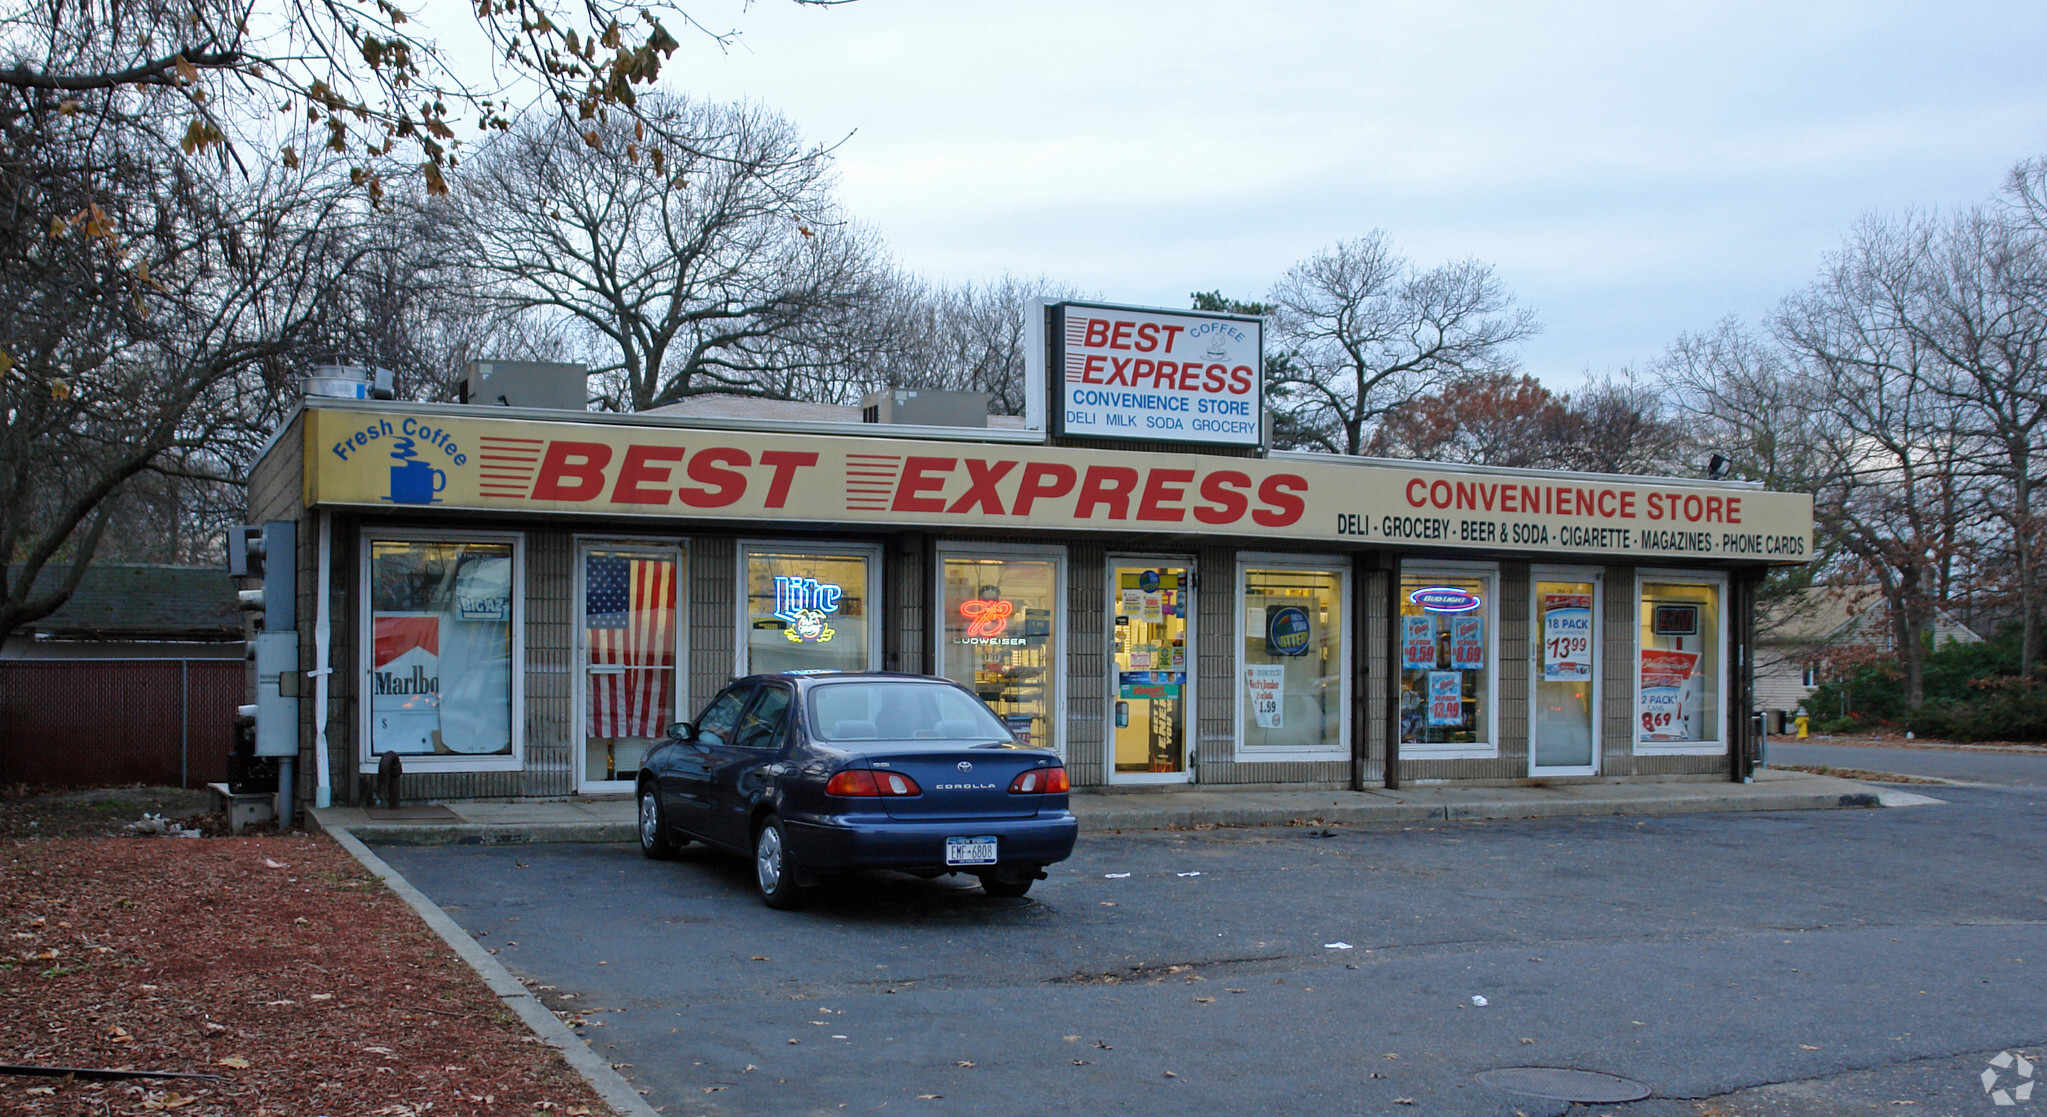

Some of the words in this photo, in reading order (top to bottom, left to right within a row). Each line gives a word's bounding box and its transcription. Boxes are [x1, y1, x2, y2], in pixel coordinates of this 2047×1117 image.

[1084, 318, 1185, 354] BEST
[1190, 322, 1246, 343] COFFEE
[1082, 354, 1254, 395] EXPRESS
[1073, 389, 1190, 412] CONVENIENCE
[1198, 398, 1250, 416] STORE
[332, 418, 393, 461] Fresh
[402, 417, 467, 466] Coffee
[1066, 410, 1096, 425] DELI
[1106, 415, 1137, 428] MILK
[1146, 416, 1184, 430] SODA
[1192, 418, 1256, 435] GROCERY
[530, 440, 820, 508] BEST
[890, 455, 1309, 528] EXPRESS
[1405, 477, 1636, 519] CONVENIENCE
[1647, 491, 1742, 524] STORE
[1337, 513, 1369, 535] DELI
[1461, 520, 1496, 542] BEER
[1500, 522, 1508, 543] &
[1512, 522, 1548, 545] SODA
[1560, 525, 1630, 549] CIGARETTE
[1641, 529, 1712, 552] MAGAZINES
[1722, 533, 1763, 553] PHONE
[1766, 535, 1804, 555] CARDS
[773, 576, 842, 622] Lite
[1548, 618, 1559, 630] 18
[1562, 618, 1588, 630] PACK
[1650, 695, 1675, 705] PACK
